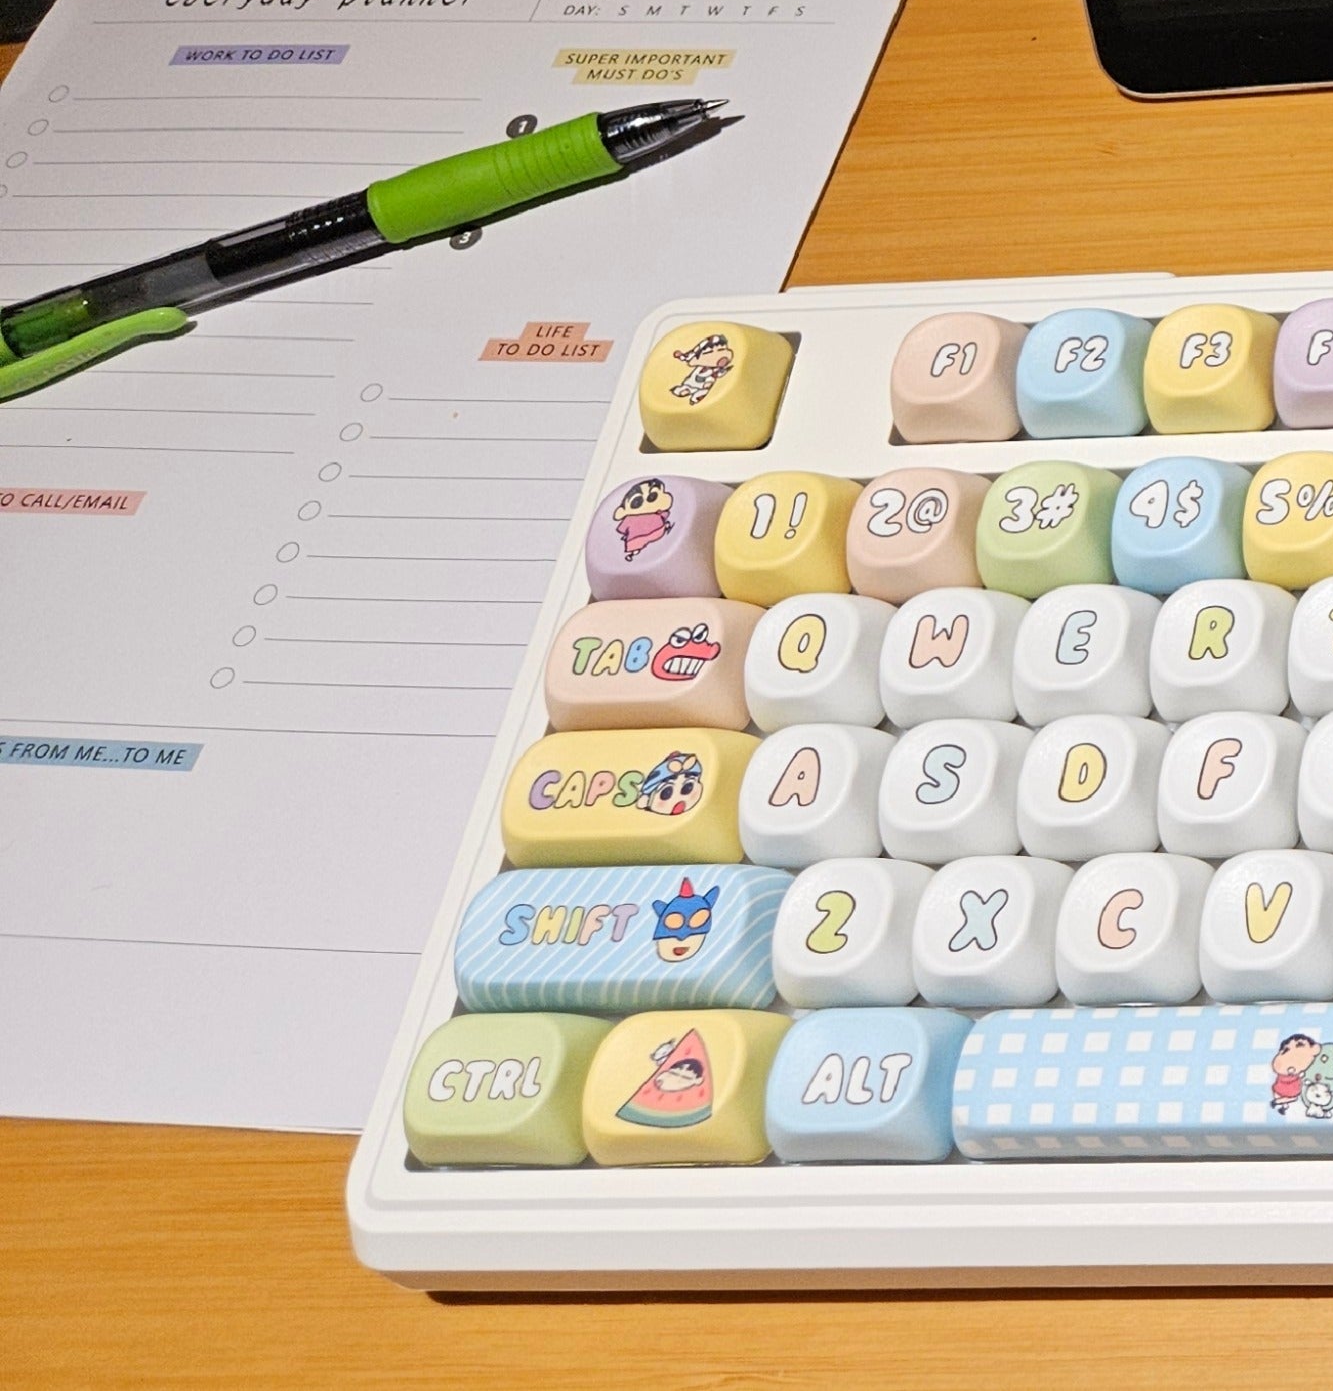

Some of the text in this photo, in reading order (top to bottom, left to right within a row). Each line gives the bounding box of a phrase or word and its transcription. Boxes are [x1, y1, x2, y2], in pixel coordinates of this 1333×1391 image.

[563, 5, 806, 17] DAY: S M T W T F S
[185, 48, 336, 61] WORK TO DO LIST
[565, 53, 728, 66] SUPER IMPORTANT
[586, 69, 685, 80] MUST DO'S
[518, 118, 528, 133] 1
[458, 231, 472, 244] 3
[497, 343, 600, 357] TO DO LIST
[535, 325, 574, 338] LIFE
[1179, 330, 1233, 369] F3
[930, 341, 978, 377] F1
[1054, 335, 1109, 374] F2
[0, 493, 129, 510] O CALL/EMAIL
[777, 613, 827, 673] Q
[908, 614, 970, 668] W
[1055, 609, 1098, 665] E
[1188, 605, 1235, 660] R
[572, 636, 653, 676] TAB
[9, 742, 70, 759] FROM
[155, 749, 187, 765] ME
[1058, 742, 1108, 802] D
[1196, 737, 1243, 801] F
[529, 770, 645, 810] CAPS
[768, 746, 821, 807] A
[915, 744, 967, 804] S
[498, 903, 640, 947] SHIFT
[948, 888, 1009, 952] X
[1097, 888, 1144, 949] C
[1244, 881, 1293, 944] V
[427, 1056, 542, 1102] CTRL
[802, 1052, 913, 1106] ALT
